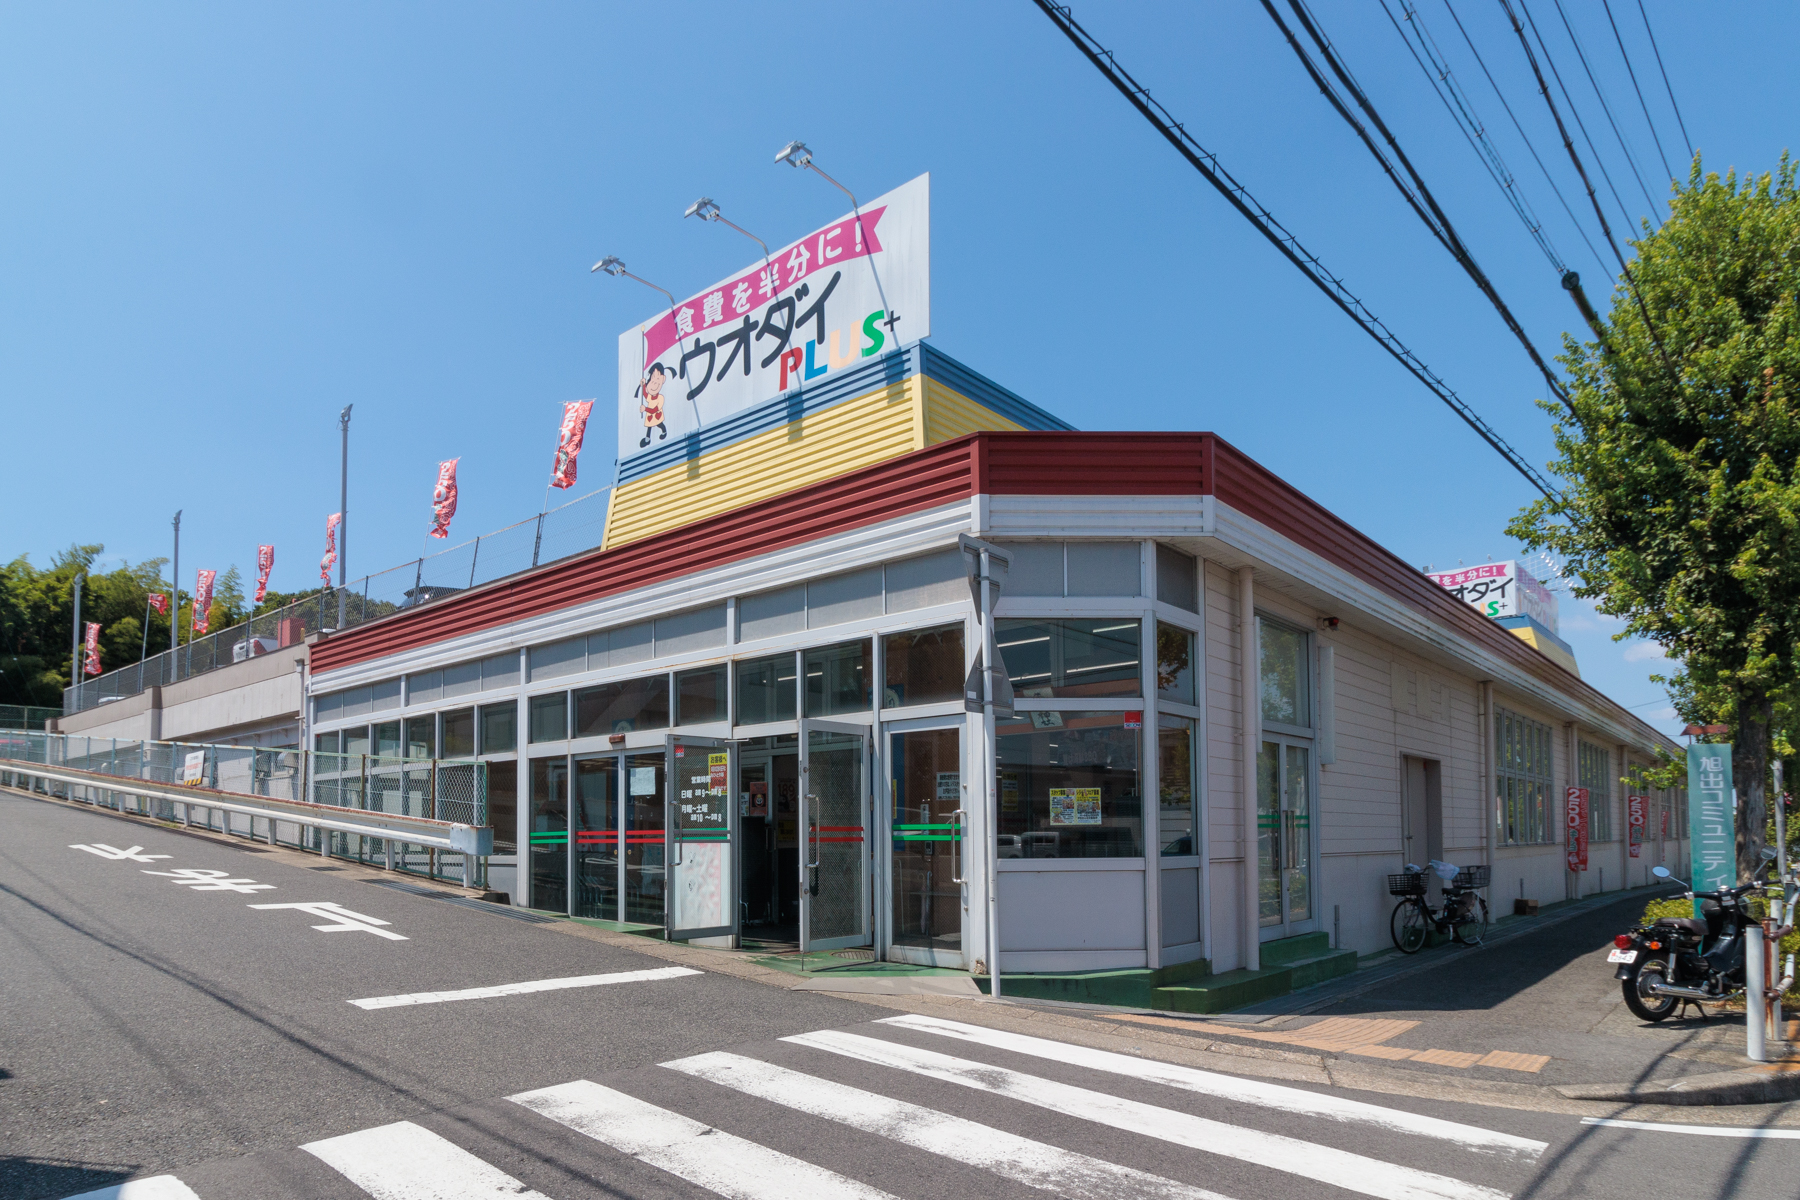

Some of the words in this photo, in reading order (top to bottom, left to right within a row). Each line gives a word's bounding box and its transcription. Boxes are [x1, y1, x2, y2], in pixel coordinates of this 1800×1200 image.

[679, 271, 842, 401] ウオダイ
[560, 403, 580, 446] 250
[197, 570, 208, 601] 250
[691, 776, 711, 784] 営業時間
[1568, 788, 1580, 827] 250
[1630, 796, 1644, 825] 250
